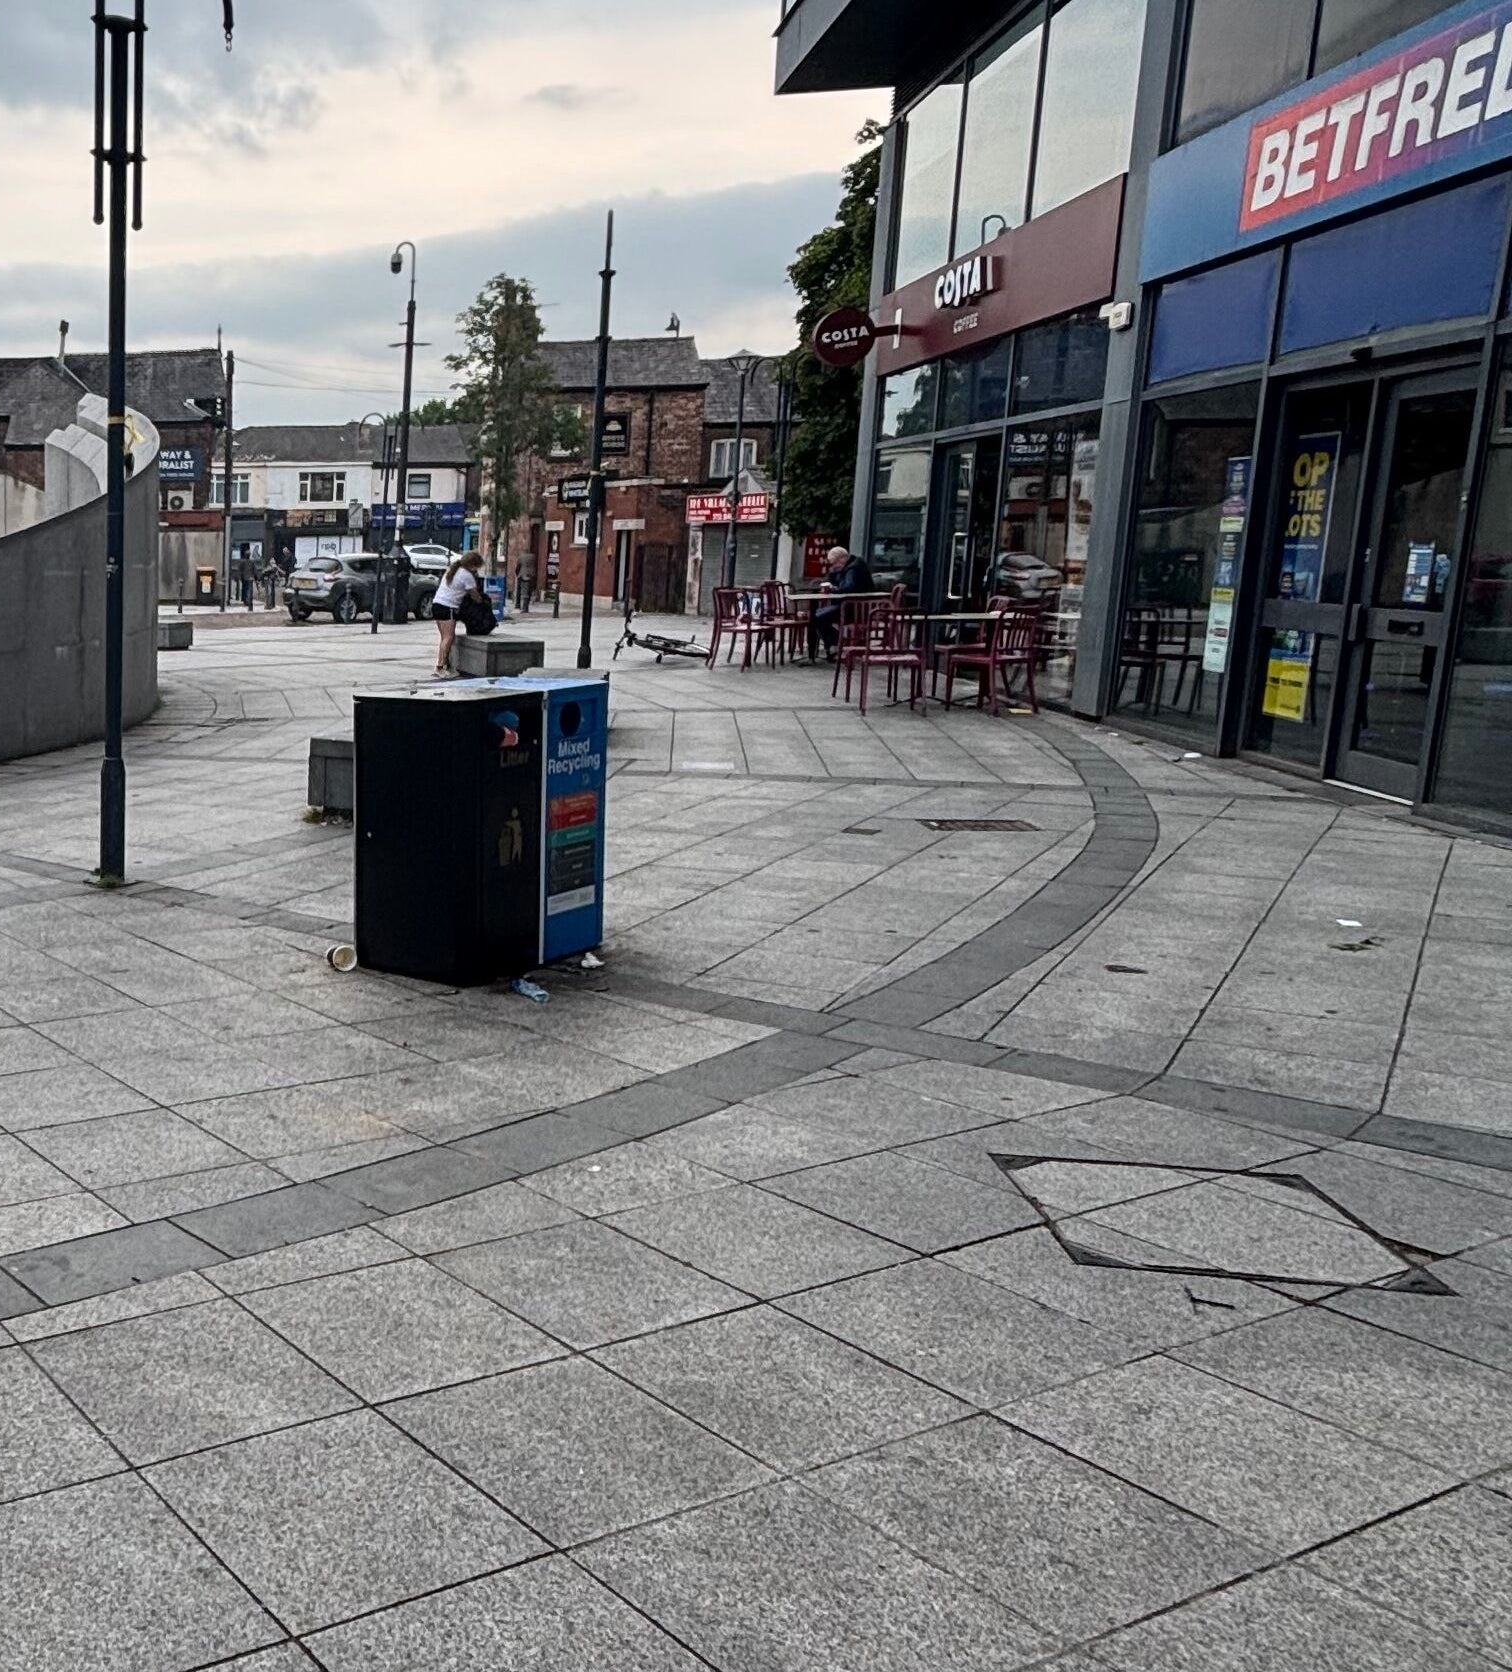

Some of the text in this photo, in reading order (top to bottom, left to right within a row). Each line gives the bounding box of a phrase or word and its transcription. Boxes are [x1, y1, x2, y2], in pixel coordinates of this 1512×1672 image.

[935, 256, 981, 309] COSTA
[821, 325, 869, 343] COSTA
[184, 450, 192, 460] &
[1285, 513, 1321, 537] OTS
[558, 738, 590, 757] Mixed
[548, 754, 600, 775] Recycling
